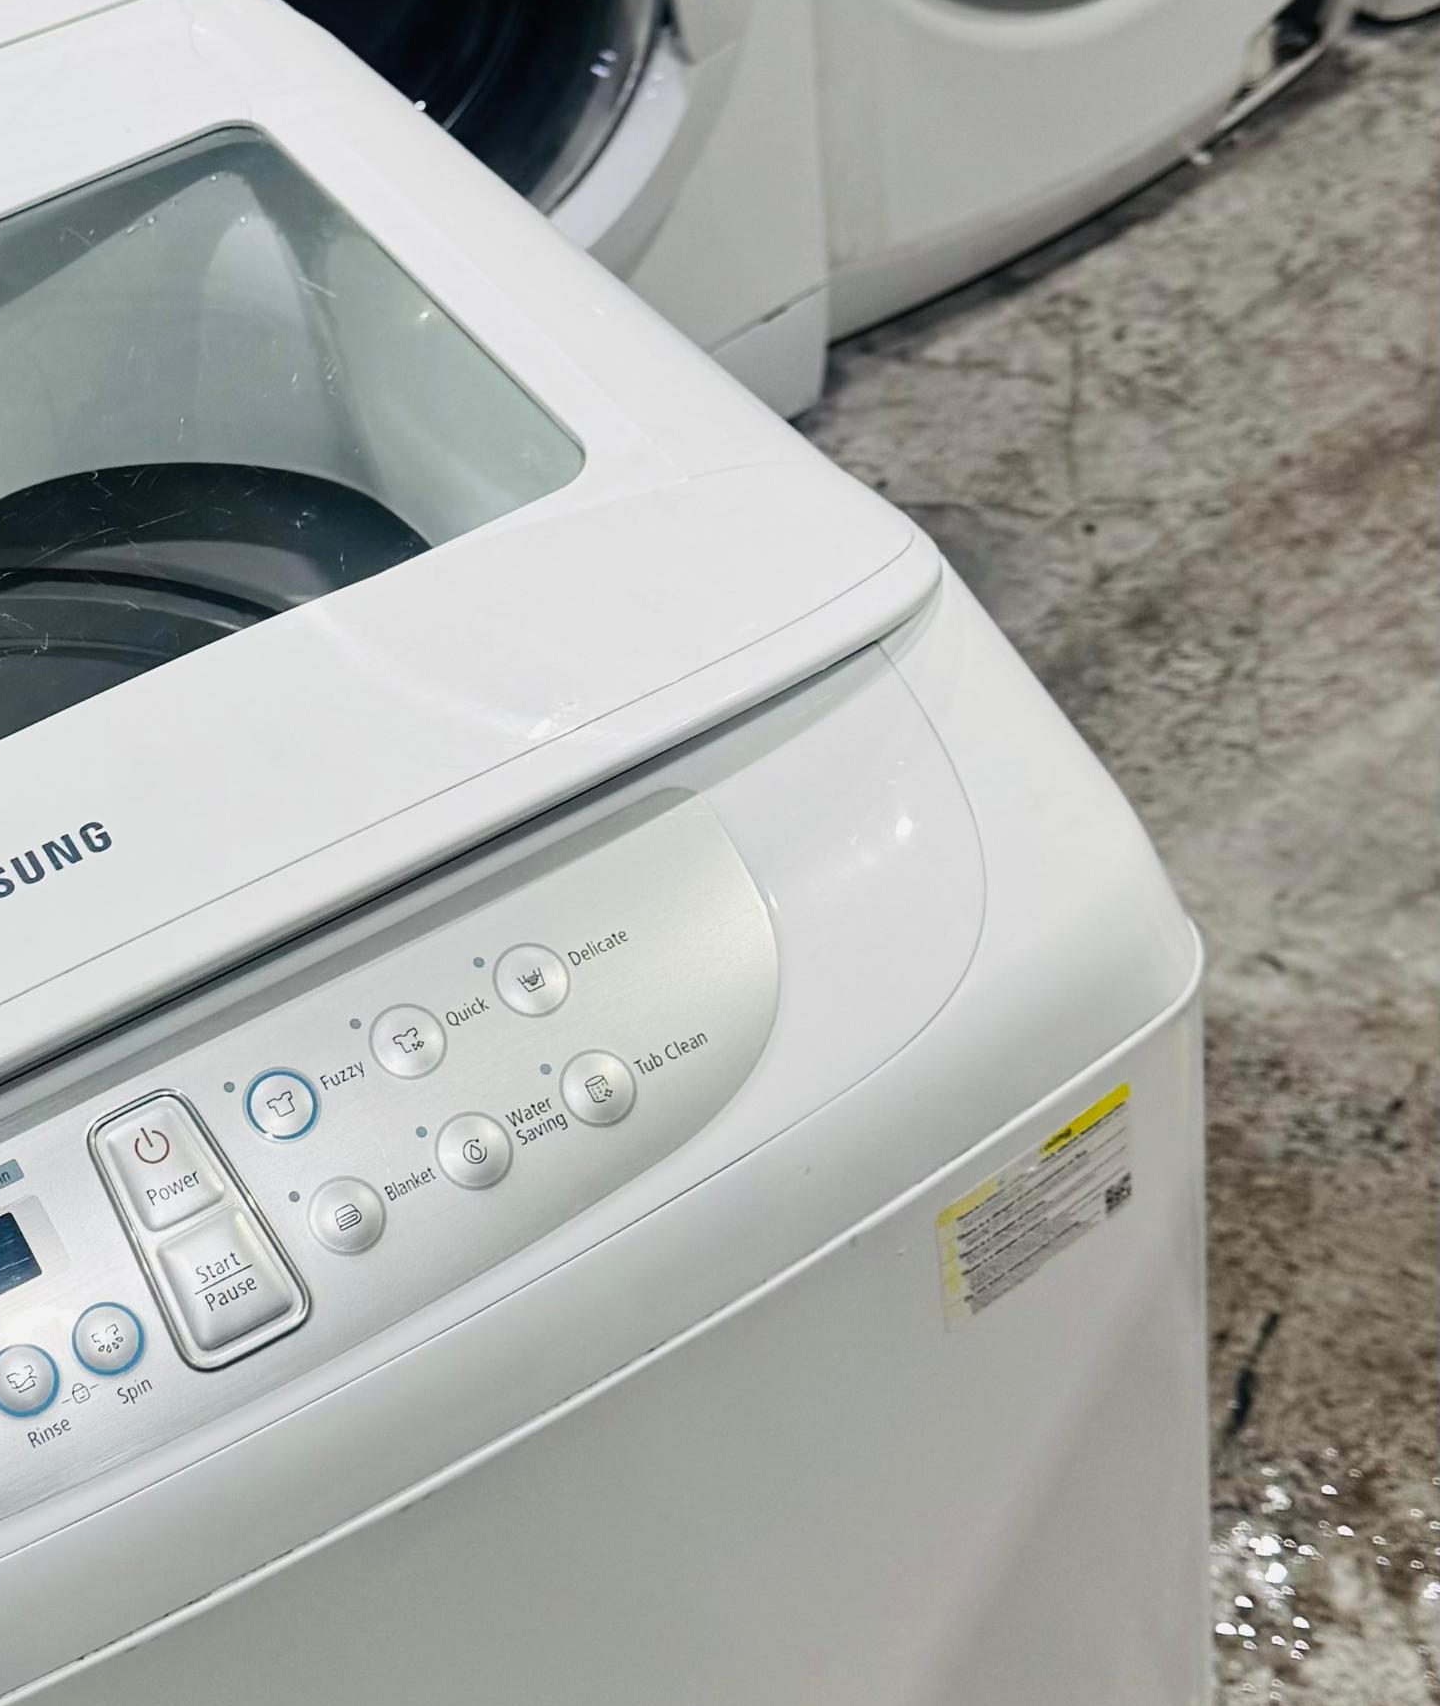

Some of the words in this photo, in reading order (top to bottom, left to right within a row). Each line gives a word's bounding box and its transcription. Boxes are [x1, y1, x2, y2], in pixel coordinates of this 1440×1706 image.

[567, 928, 629, 967] Delicate
[445, 996, 490, 1029] Quick
[634, 1053, 664, 1077] Tub
[664, 1030, 709, 1062] Clean
[320, 1060, 365, 1091] Fuzzy
[505, 1096, 553, 1129] Water
[516, 1113, 569, 1147] Saving
[145, 1169, 201, 1206] Power
[384, 1166, 437, 1202] Blanket
[196, 1250, 242, 1285] Start
[205, 1275, 258, 1312] Pause
[117, 1376, 154, 1406] Spin
[27, 1417, 72, 1449] Rinse
